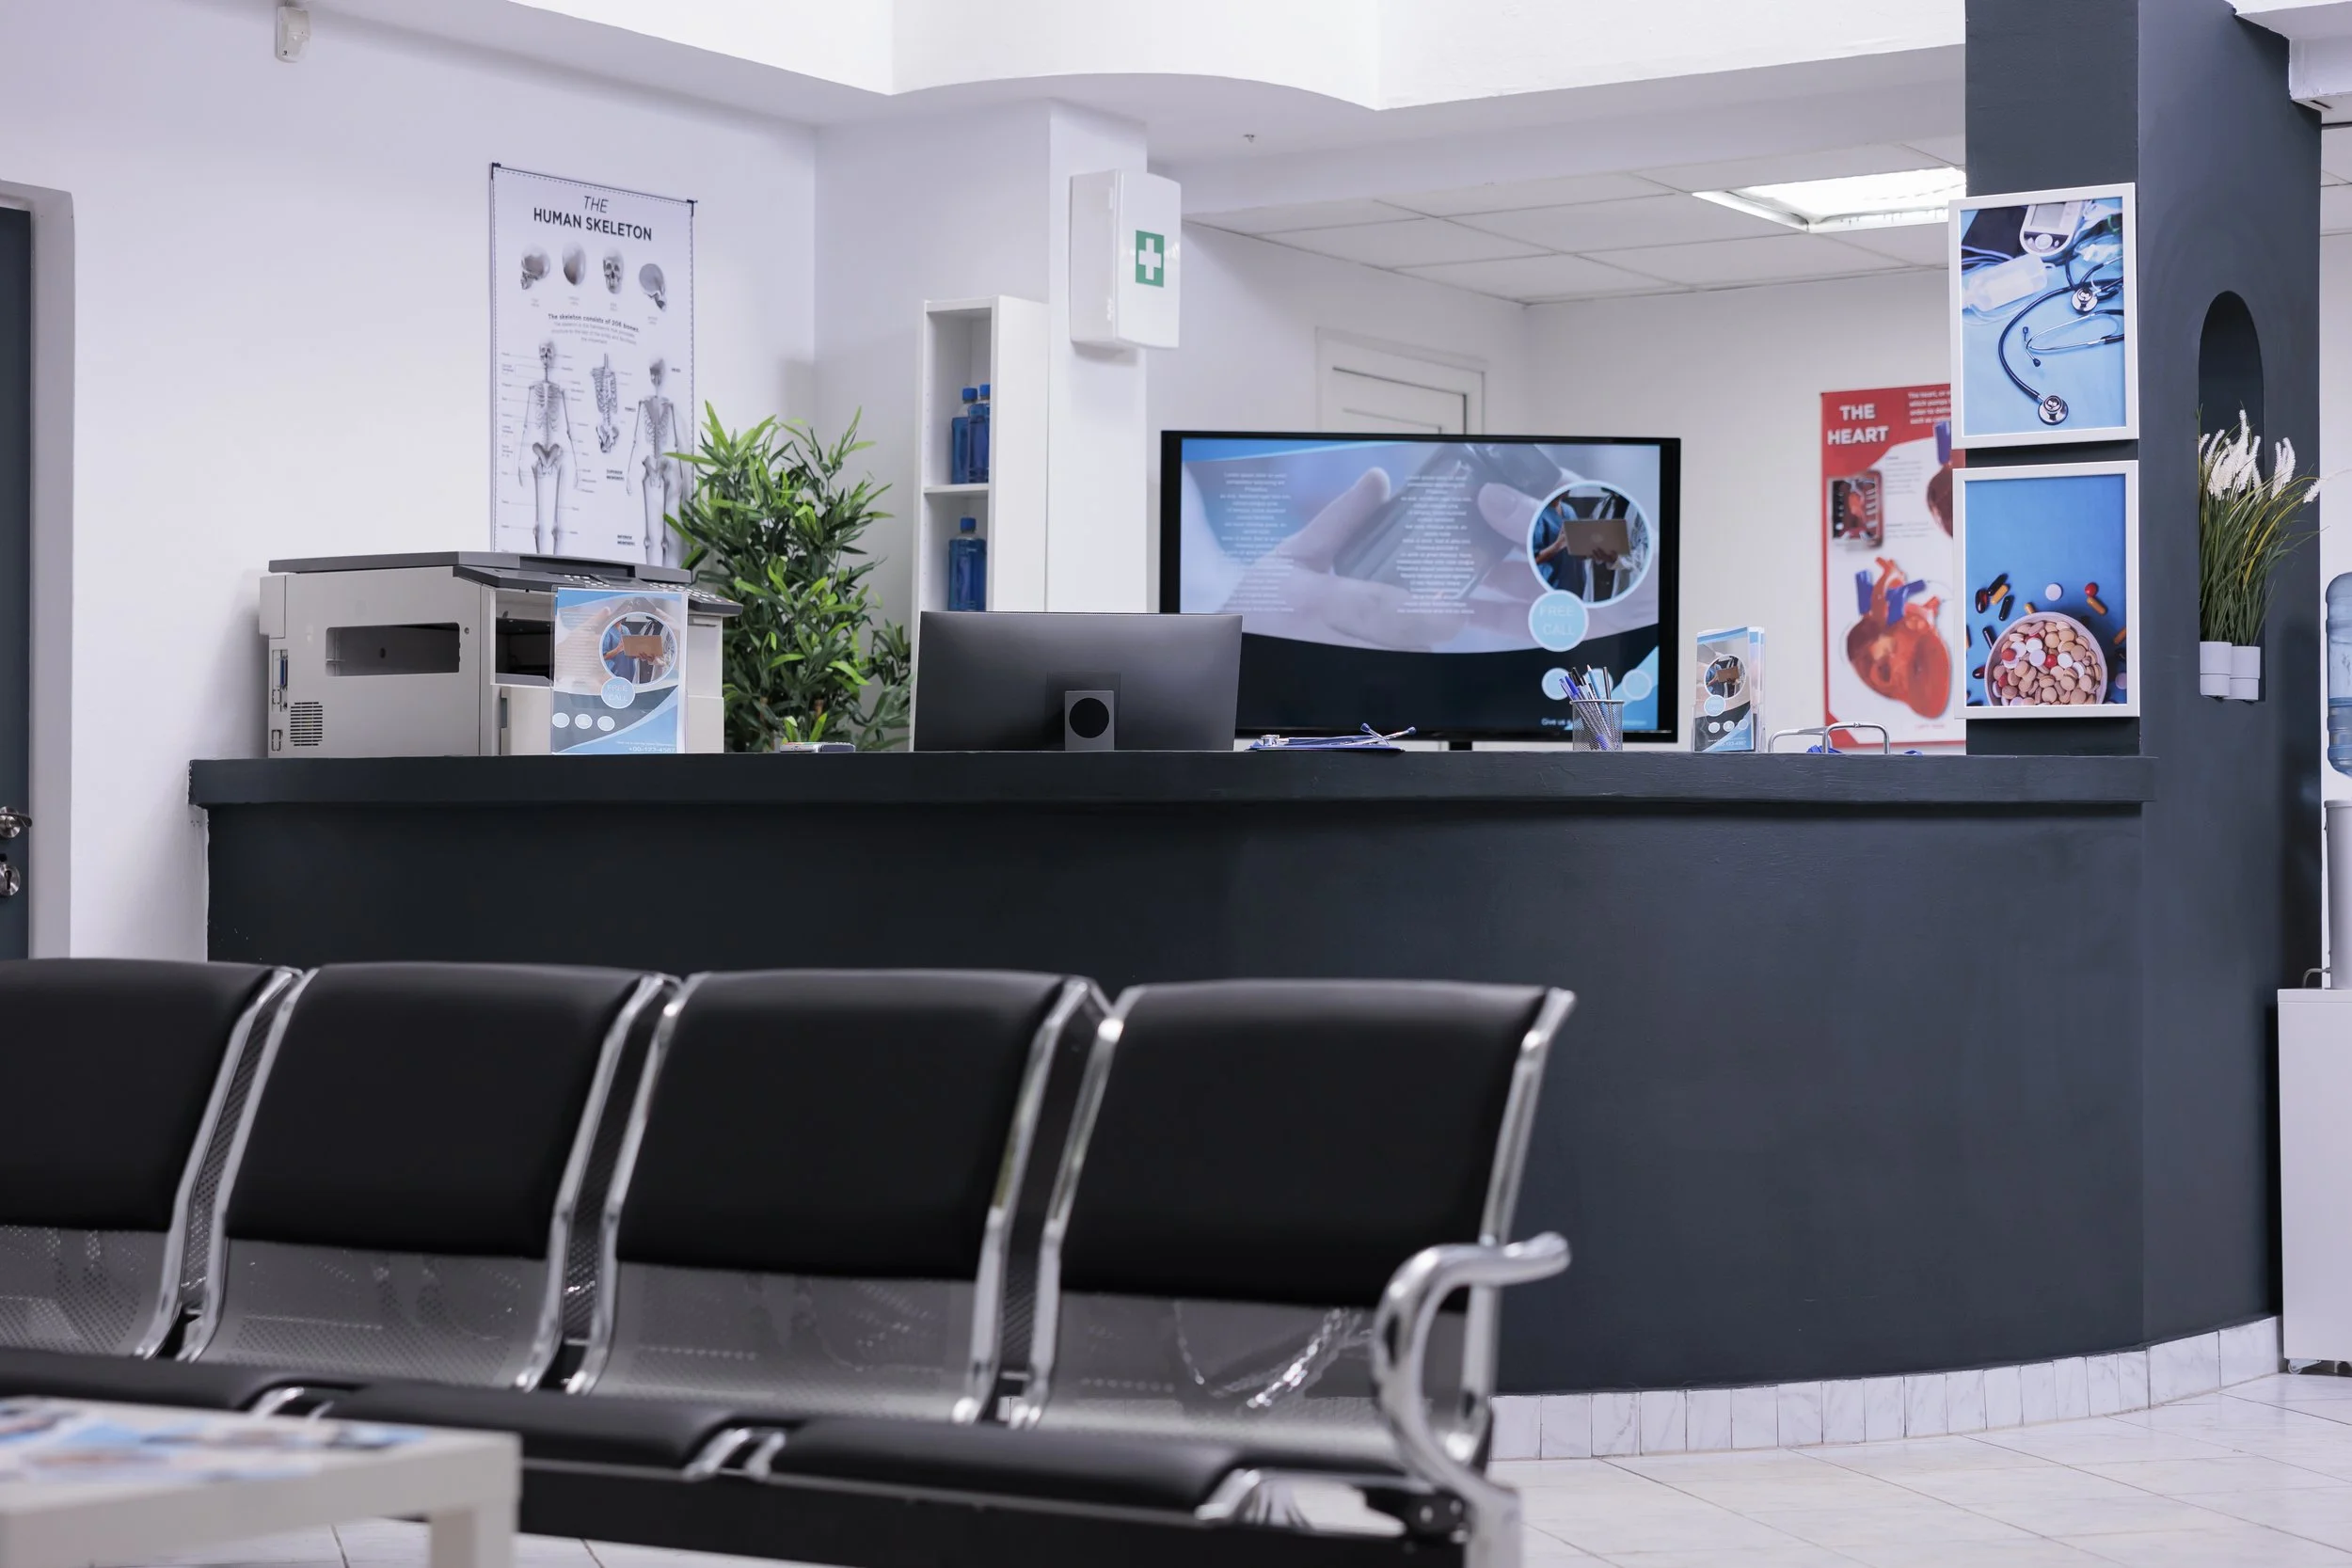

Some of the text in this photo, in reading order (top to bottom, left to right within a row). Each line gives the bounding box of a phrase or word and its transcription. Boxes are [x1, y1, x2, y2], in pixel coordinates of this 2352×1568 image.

[583, 195, 609, 214] THE
[533, 207, 652, 242] HUMAN SKELETON
[582, 316, 604, 325] consists
[1839, 403, 1876, 420] THE
[1827, 425, 1889, 446] HEART
[1539, 605, 1575, 617] FREE
[1542, 623, 1575, 636] CALL
[607, 684, 629, 692] FREE
[608, 693, 628, 702] CALL
